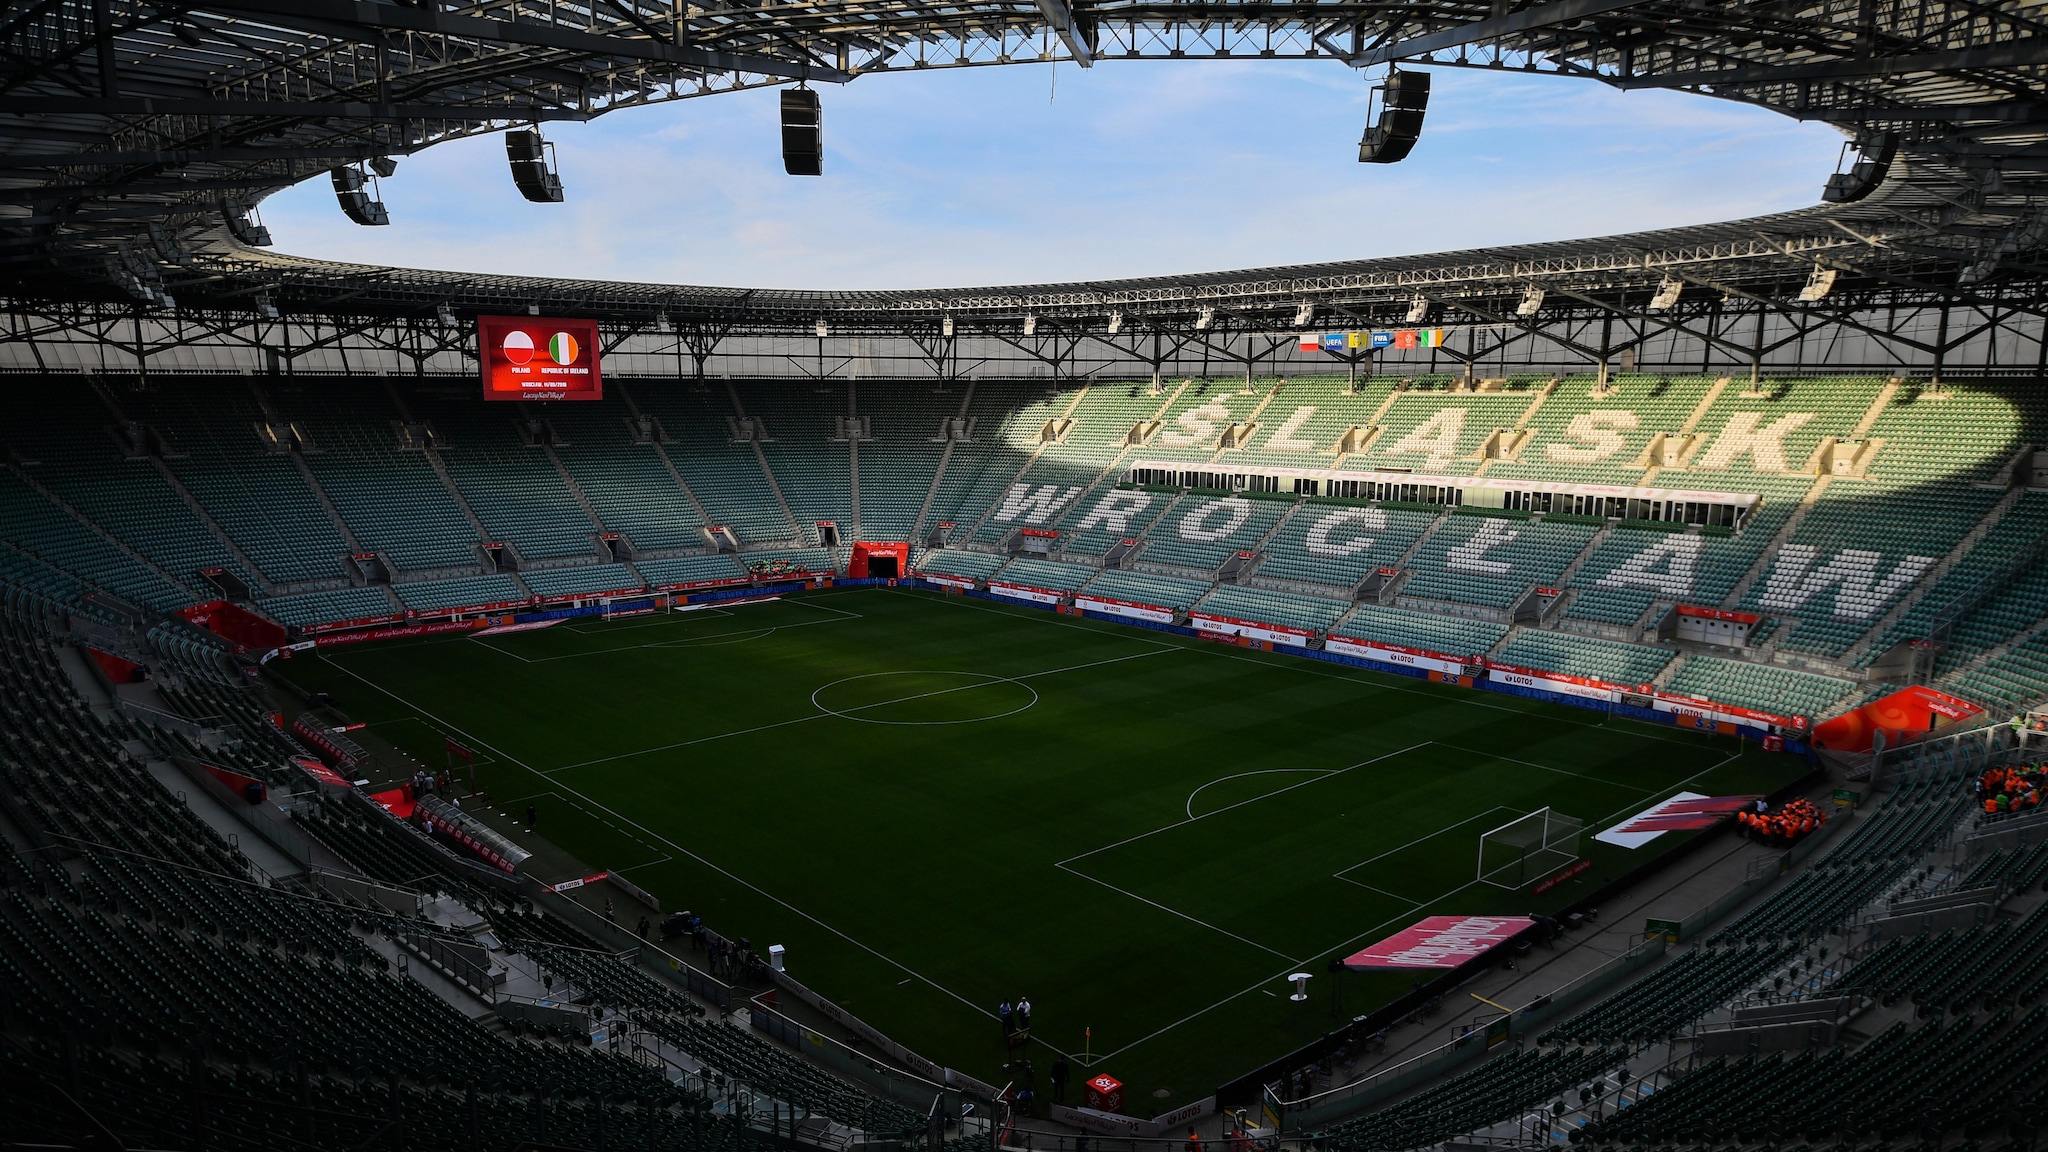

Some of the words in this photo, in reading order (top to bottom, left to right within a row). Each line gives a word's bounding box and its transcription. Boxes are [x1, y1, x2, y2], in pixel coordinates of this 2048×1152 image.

[992, 483, 1935, 620] WROCŁAW
[1208, 622, 1222, 630] LOTOS
[1398, 655, 1414, 664] LOTOS
[1514, 676, 1533, 686] LOTOS
[1680, 708, 1704, 718] LOTOS
[826, 1003, 842, 1020] LOTOS
[914, 1057, 933, 1075] LOTOS
[1178, 1104, 1202, 1121] LOTOS
